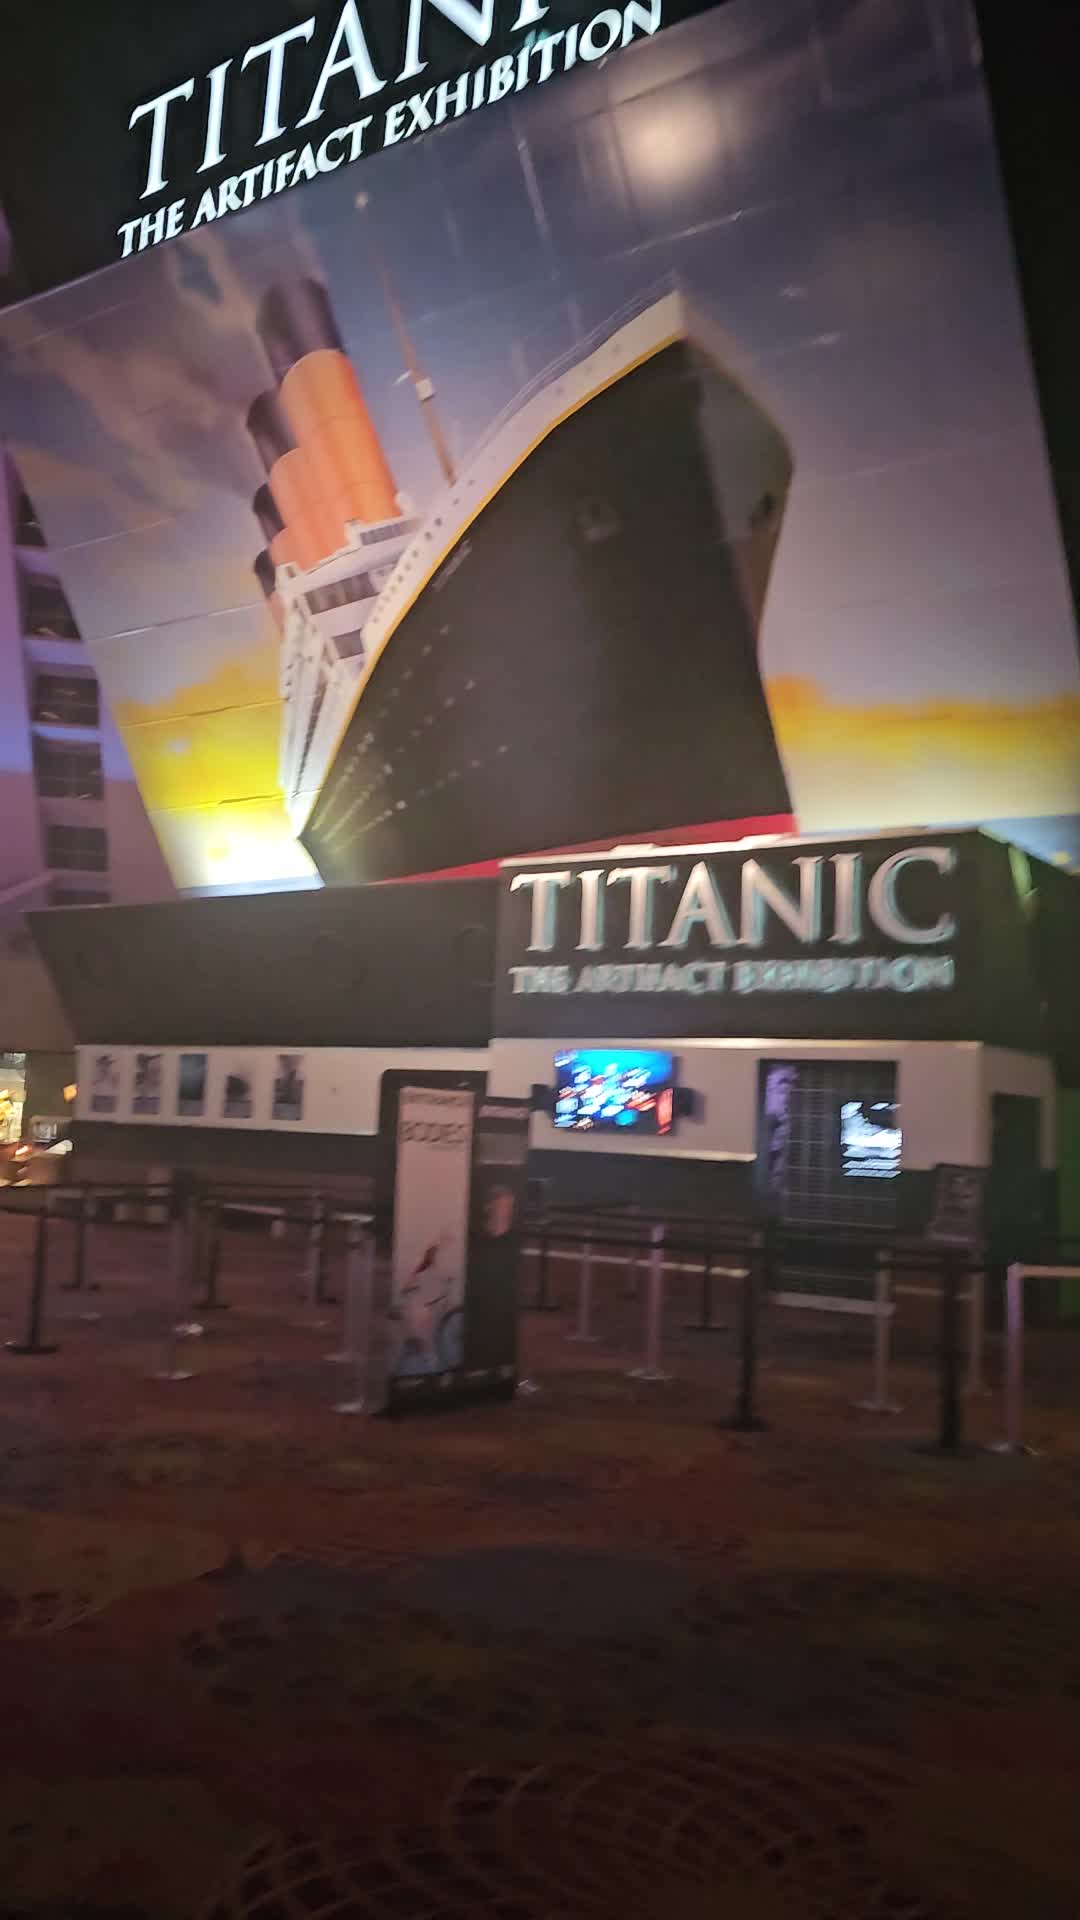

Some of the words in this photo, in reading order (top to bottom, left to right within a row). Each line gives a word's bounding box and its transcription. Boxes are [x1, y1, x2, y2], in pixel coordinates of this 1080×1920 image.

[116, 198, 187, 259] THE
[190, 115, 373, 230] ARTIFACT
[383, 0, 662, 149] EXHIBITION
[509, 846, 957, 952] TITANIC
[508, 964, 571, 995] THE
[573, 961, 728, 995] ARTIFACT
